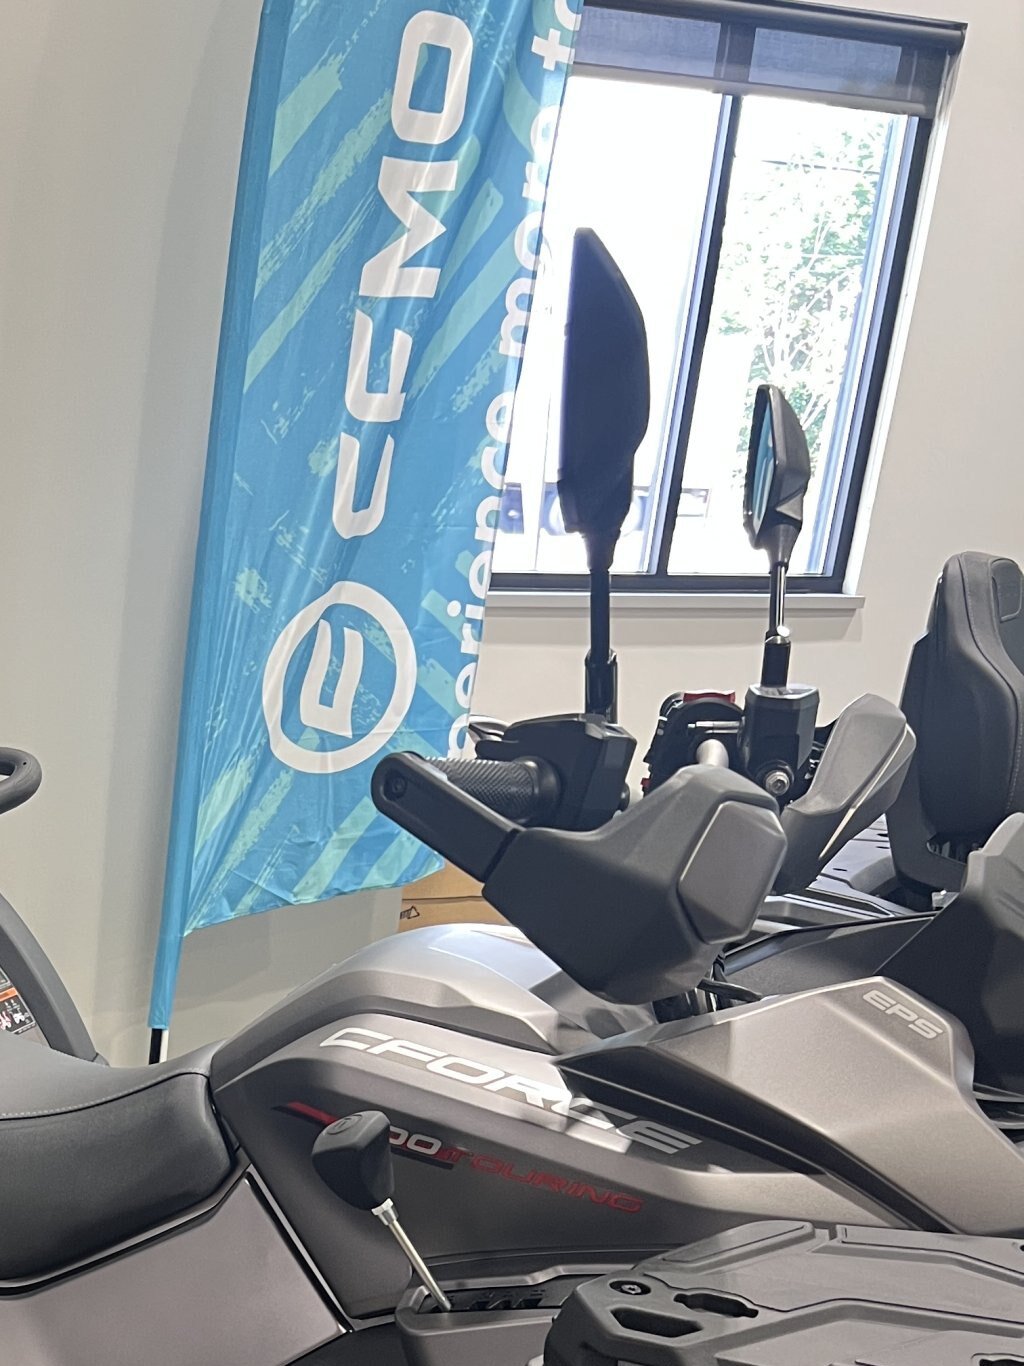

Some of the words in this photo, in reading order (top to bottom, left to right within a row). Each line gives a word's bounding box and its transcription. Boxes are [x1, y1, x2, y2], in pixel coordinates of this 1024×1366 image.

[332, 9, 474, 540] CFMO
[862, 989, 944, 1040] EPS
[319, 1026, 704, 1155] CFORCE
